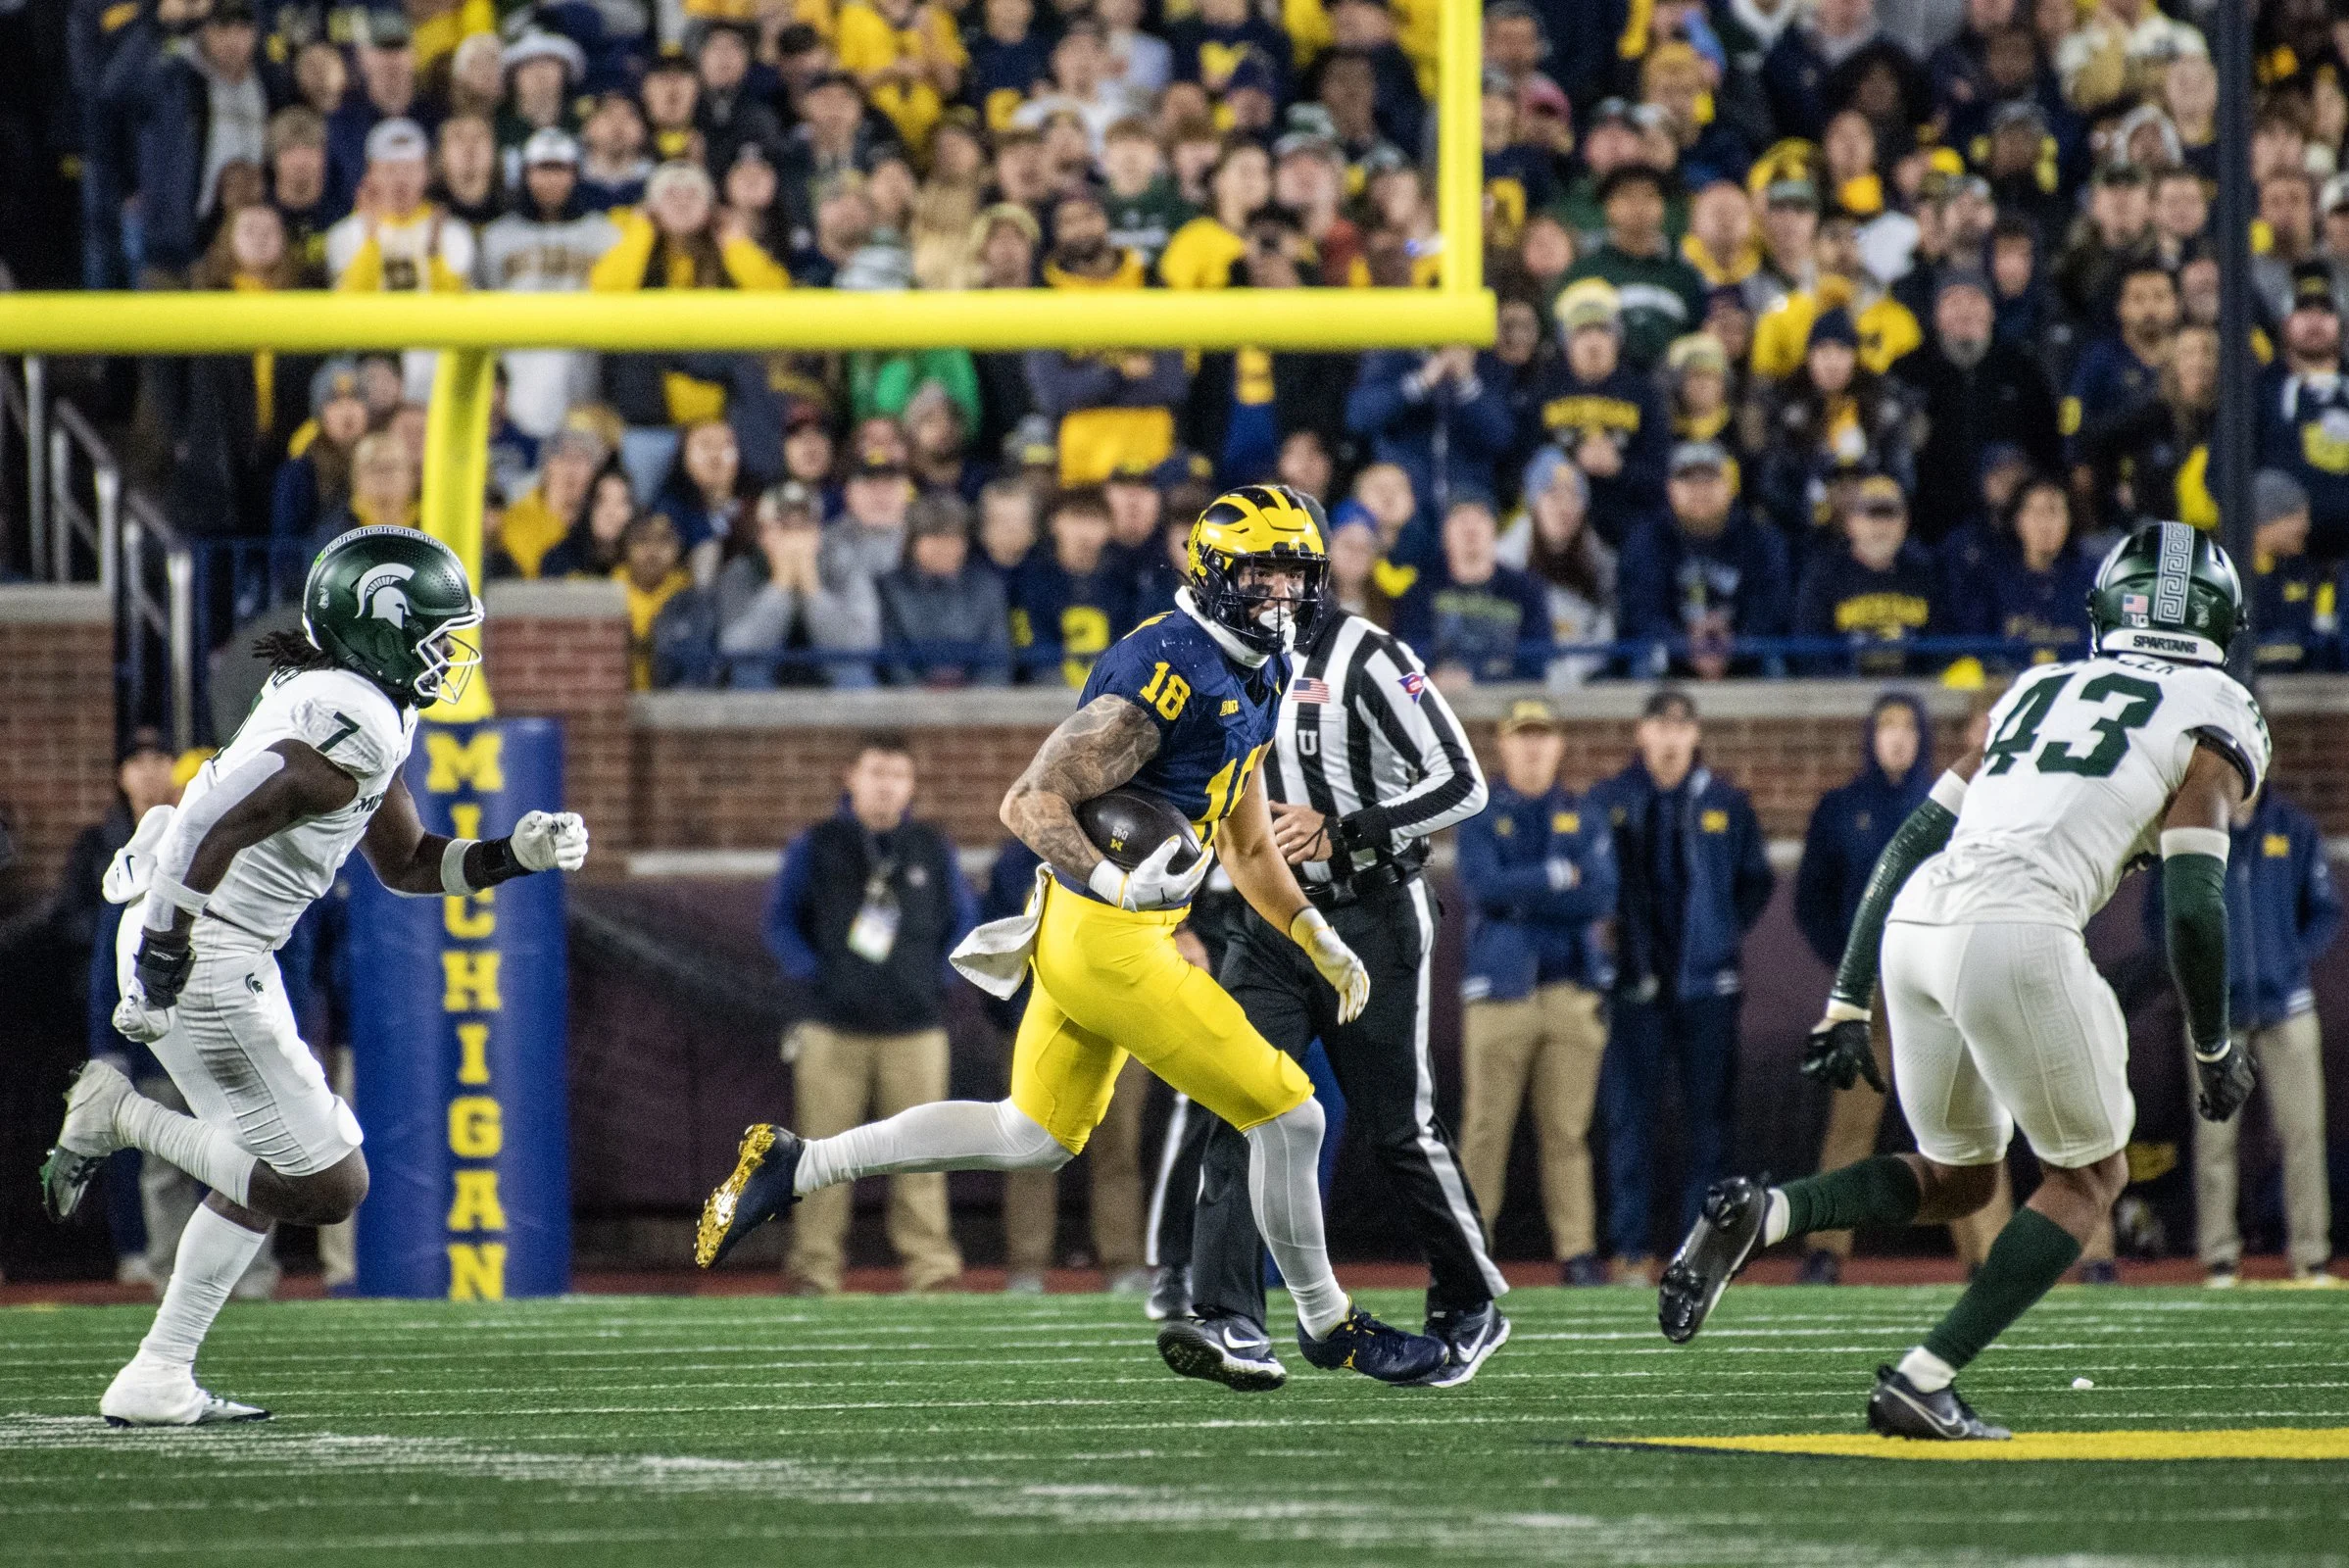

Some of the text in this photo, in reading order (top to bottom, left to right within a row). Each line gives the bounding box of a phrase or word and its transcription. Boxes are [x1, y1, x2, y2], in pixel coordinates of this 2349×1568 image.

[2132, 635, 2198, 654] SPARTANS
[1140, 662, 1191, 720] 18
[317, 711, 361, 753] 7
[1984, 672, 2164, 776] 43
[1297, 729, 1318, 756] U
[1110, 838, 1124, 852] M
